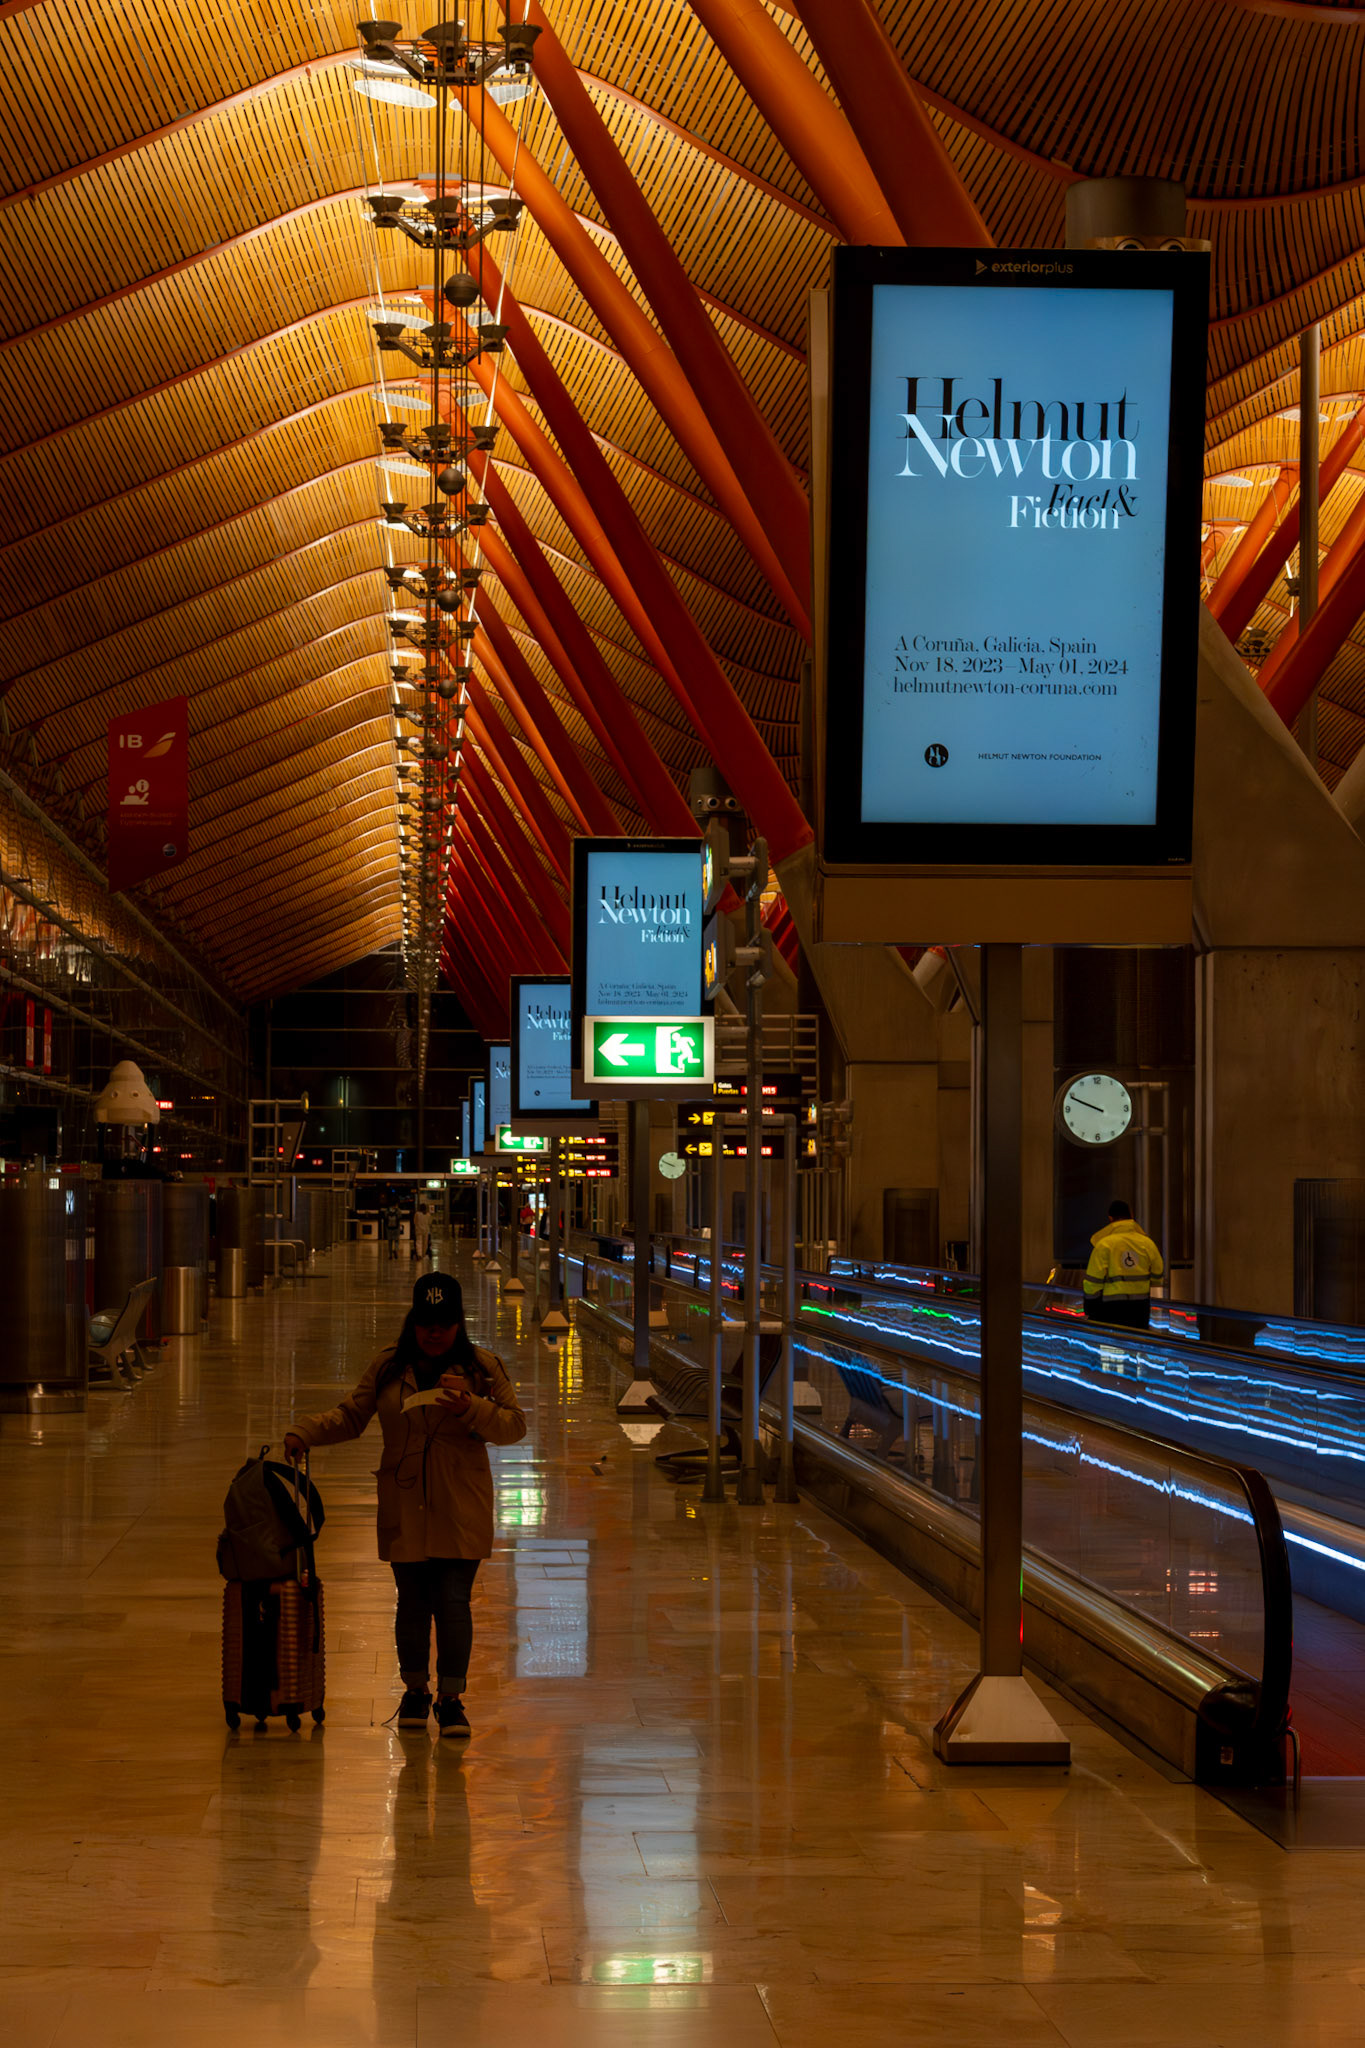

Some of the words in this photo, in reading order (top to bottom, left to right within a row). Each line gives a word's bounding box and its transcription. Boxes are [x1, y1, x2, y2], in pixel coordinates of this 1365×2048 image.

[991, 260, 1074, 275] exteriorplus
[896, 376, 1140, 442] Helmut
[895, 413, 1140, 481] Newton
[1046, 483, 1111, 516] Fact
[1112, 484, 1140, 517] &
[1006, 495, 1121, 529] Fiction
[894, 635, 909, 652] A
[984, 636, 1045, 654] Galicia,
[1049, 637, 1097, 658] Spain
[894, 656, 930, 672] Nov
[1088, 659, 1129, 675] 2024
[893, 676, 1118, 696] helmutnewton-coruna.com
[118, 733, 144, 749] IB
[1049, 753, 1102, 761] FOUNDATION
[600, 886, 687, 909] Helmut
[598, 899, 691, 925] Newton
[641, 929, 685, 943] Fiction
[527, 1013, 571, 1029] Newto
[528, 1005, 571, 1020] Helm
[552, 1031, 571, 1041] Ficti
[1095, 1133, 1101, 1141] 6
